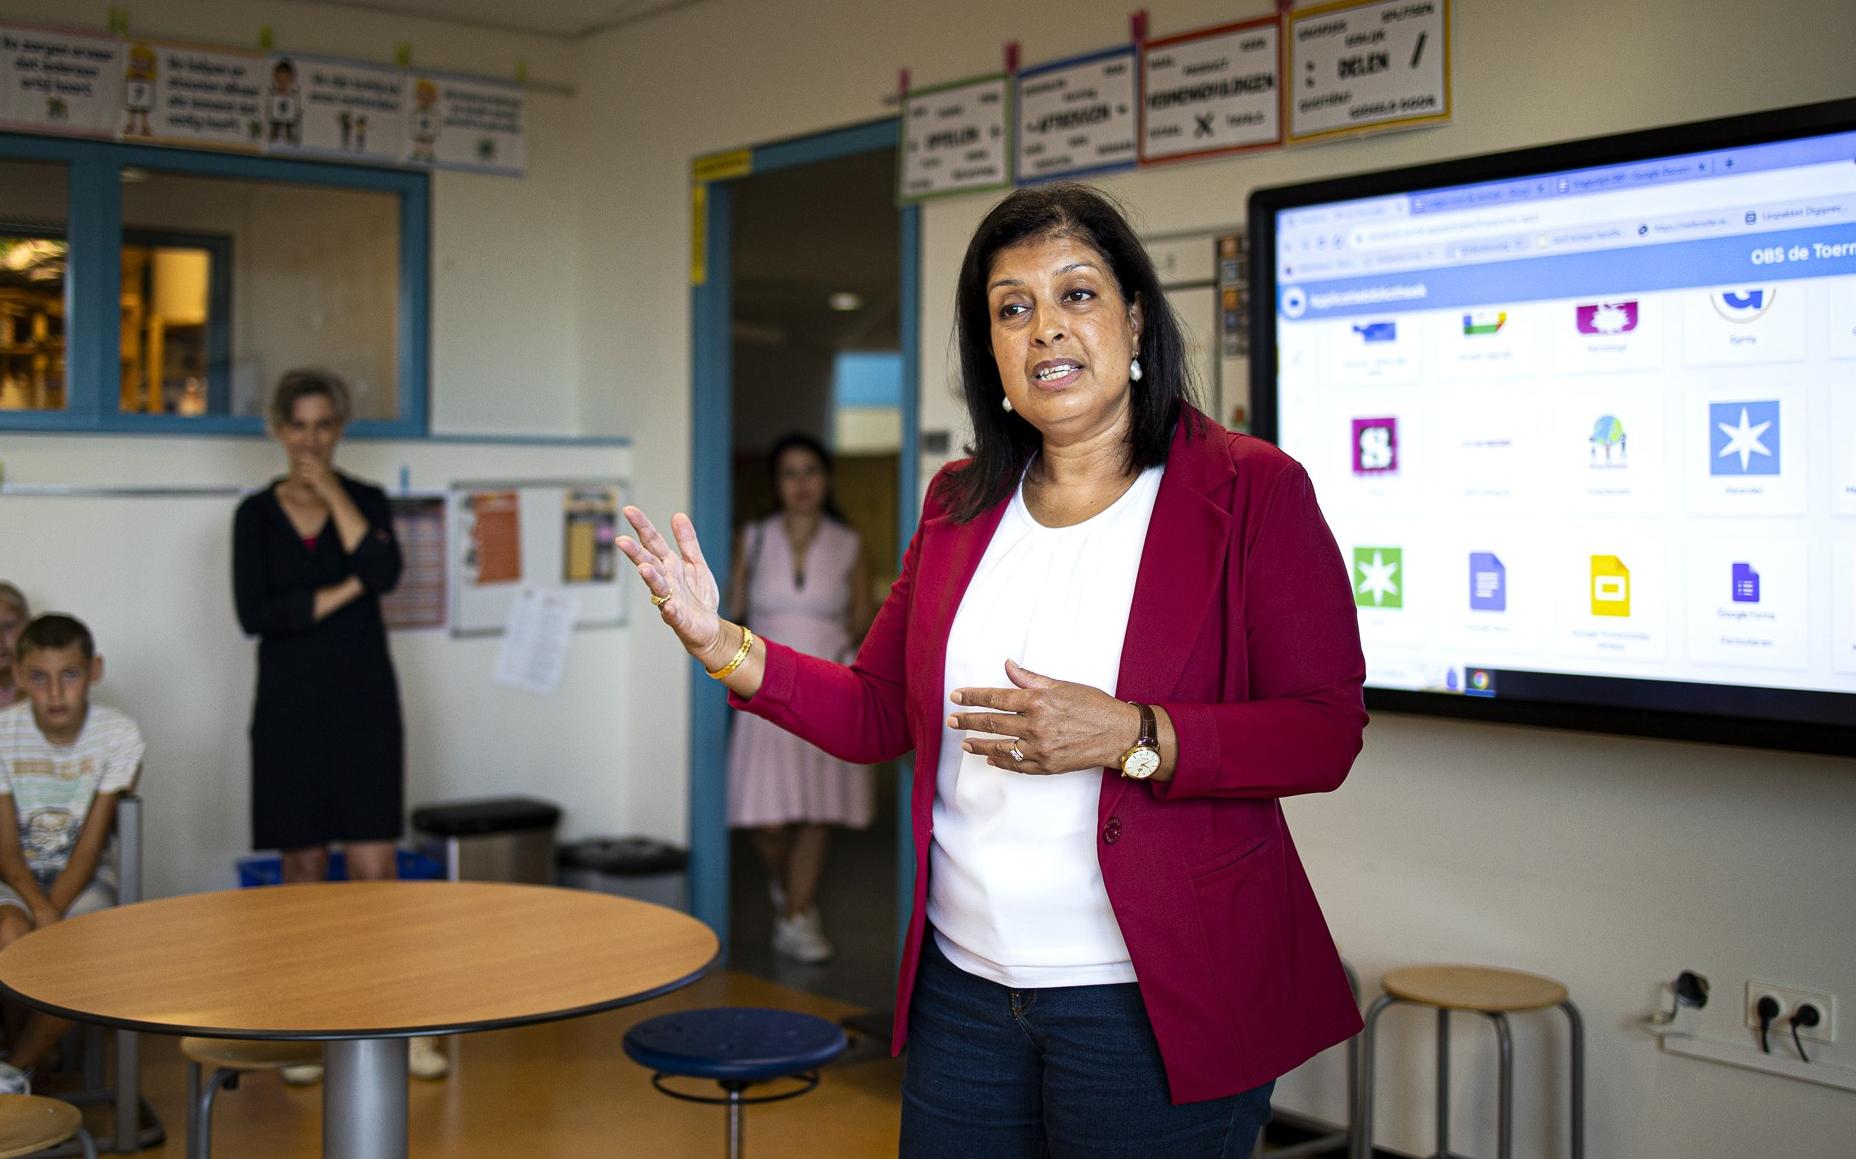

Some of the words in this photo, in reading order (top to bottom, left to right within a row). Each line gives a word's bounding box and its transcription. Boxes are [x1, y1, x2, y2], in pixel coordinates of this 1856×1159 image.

[1337, 50, 1389, 80] DELEN
[1751, 247, 1785, 265] OBS
[1788, 245, 1809, 261] de
